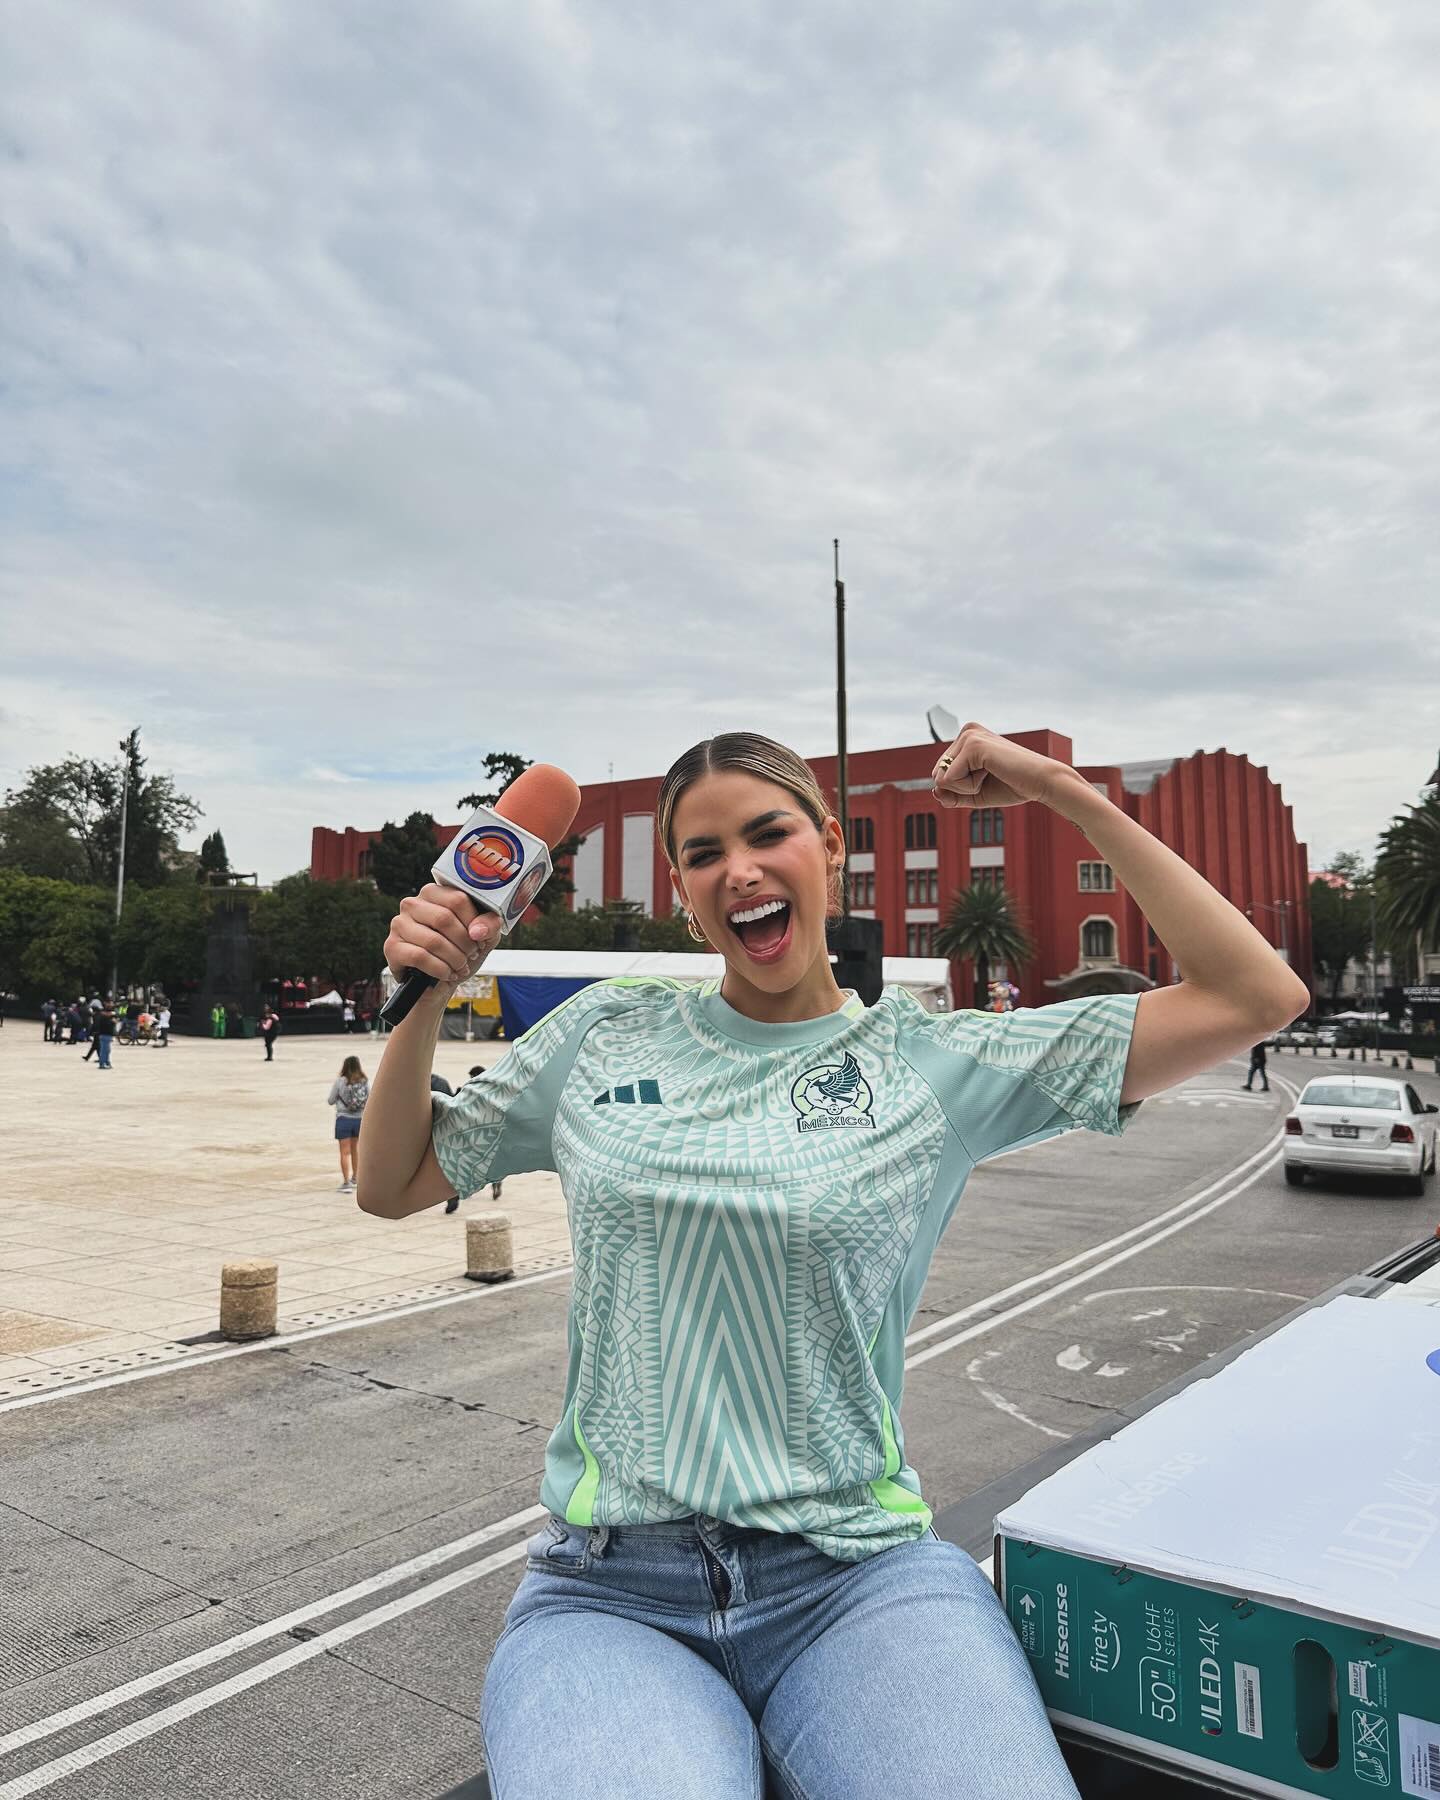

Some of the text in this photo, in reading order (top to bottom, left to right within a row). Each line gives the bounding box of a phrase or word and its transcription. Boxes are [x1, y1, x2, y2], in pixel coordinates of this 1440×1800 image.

[1054, 1583, 1070, 1679] Hisense
[1144, 1601, 1163, 1652] U6HF
[1163, 1607, 1176, 1657] SERIES
[1198, 1617, 1220, 1655] 4K
